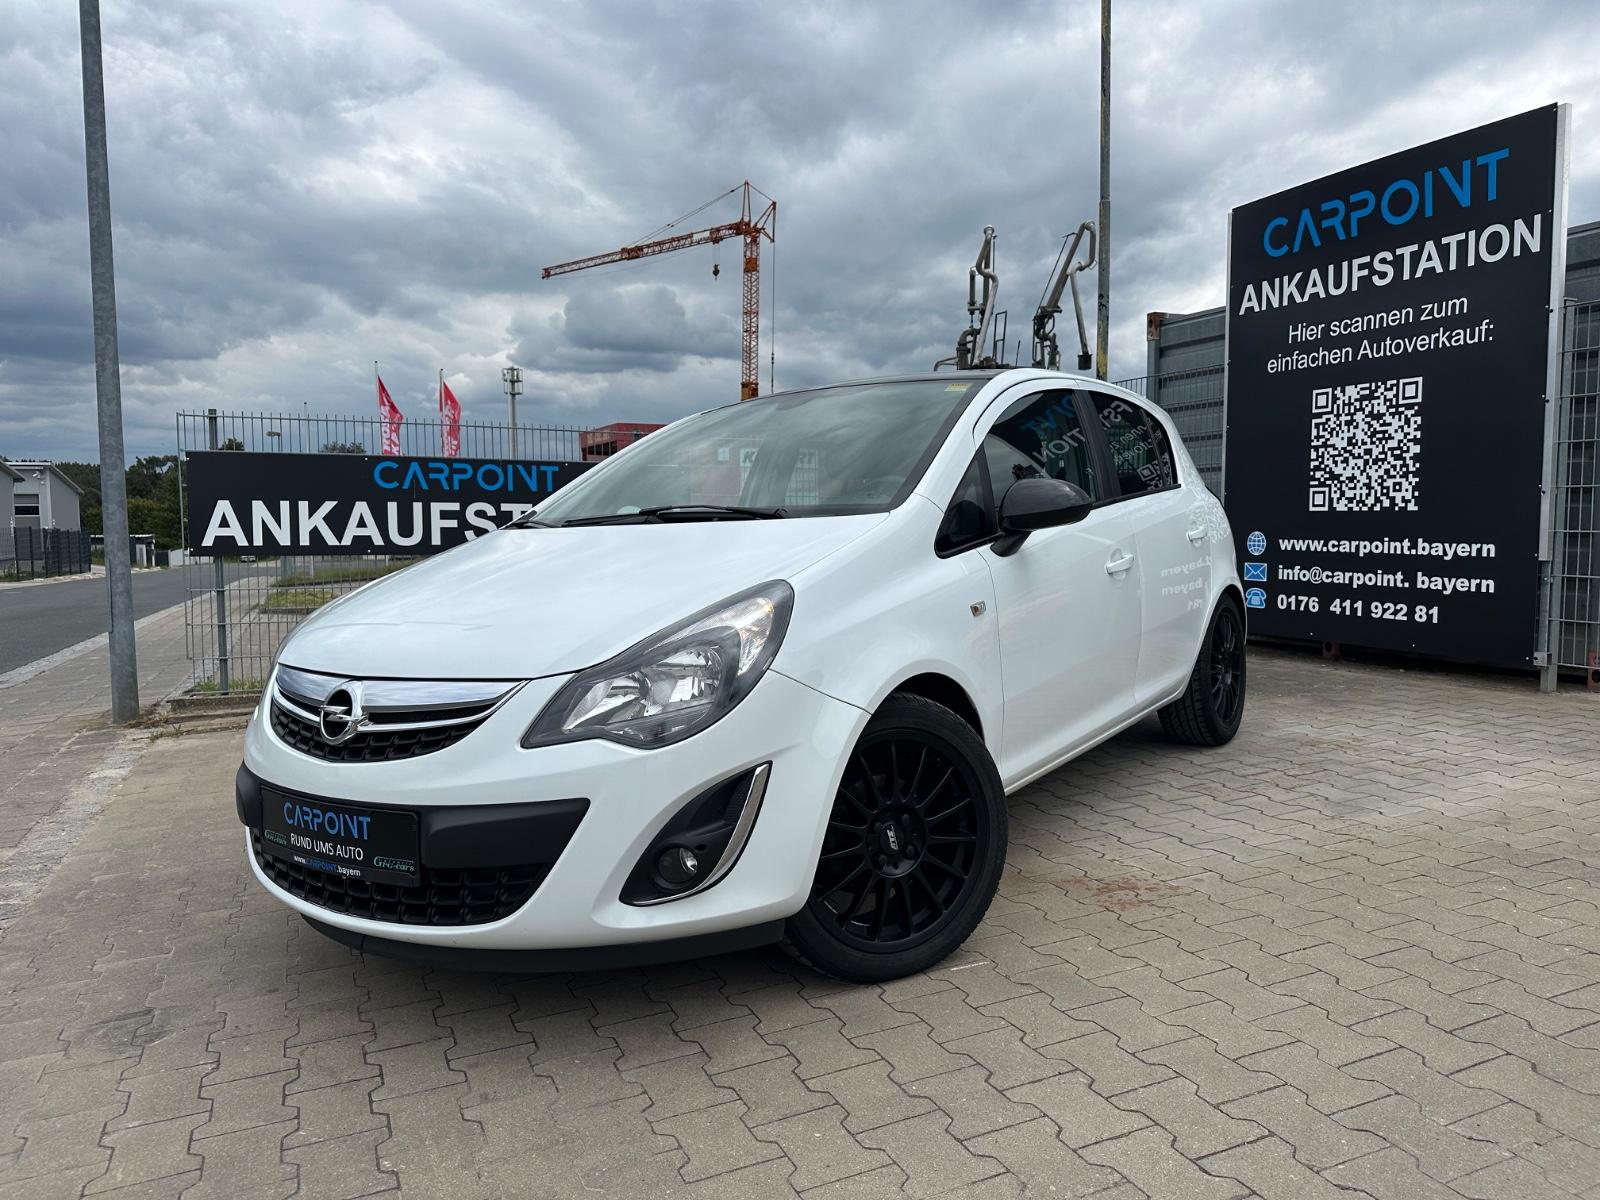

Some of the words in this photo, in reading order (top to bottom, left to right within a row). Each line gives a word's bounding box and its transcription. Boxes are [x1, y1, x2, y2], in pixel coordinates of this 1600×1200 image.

[1264, 148, 1509, 258] CARPOINT
[1239, 214, 1542, 315] ANKAUFSTATION
[1288, 322, 1325, 344] Hier
[1329, 307, 1414, 336] scannen
[1420, 297, 1468, 320] zum
[1267, 346, 1353, 374] einfachen
[1357, 319, 1494, 361] Autoverkauf:
[373, 461, 560, 492] CARPOINT
[1278, 537, 1496, 561] www.carpoint.bayern
[1417, 571, 1495, 595] bayern
[1277, 594, 1320, 613] 0176
[1330, 598, 1363, 617] 411
[1371, 602, 1408, 621] 922
[1415, 605, 1439, 623] 81
[283, 802, 371, 841] CARPOINT
[290, 833, 312, 850] RUND
[314, 840, 334, 855] UMS
[336, 844, 363, 861] AUTO
